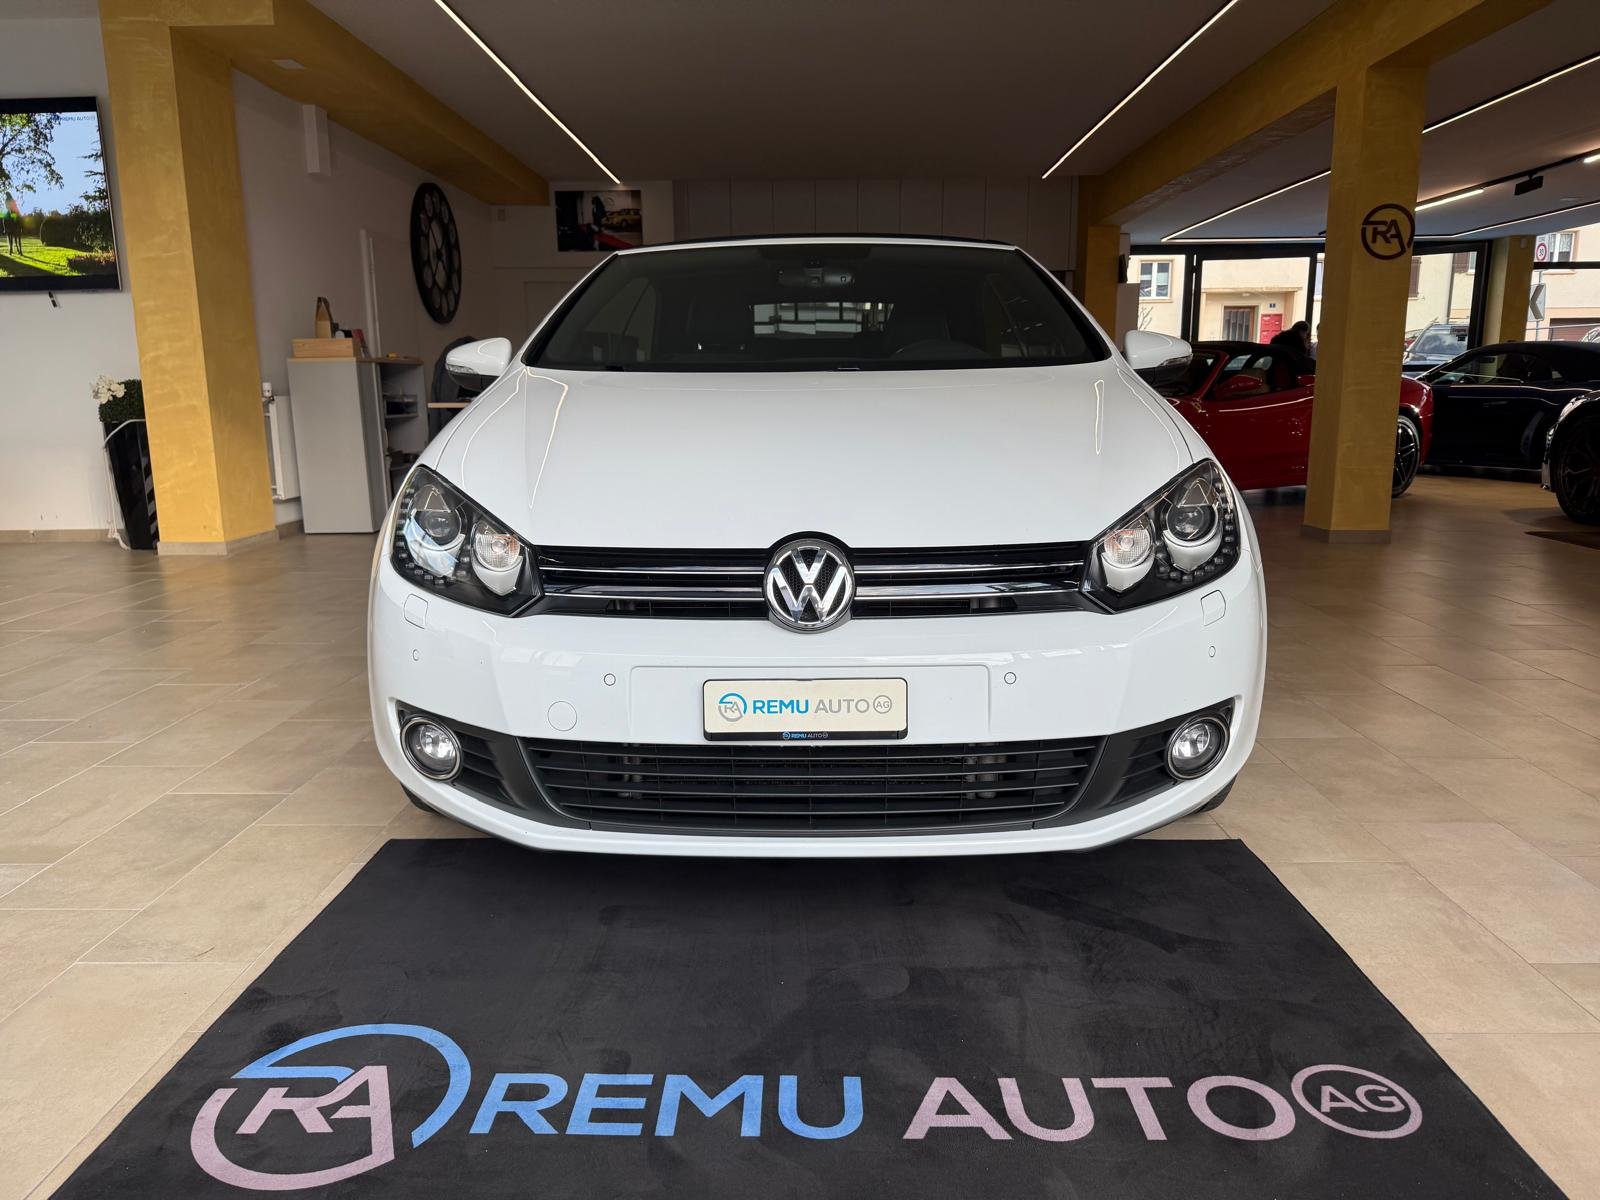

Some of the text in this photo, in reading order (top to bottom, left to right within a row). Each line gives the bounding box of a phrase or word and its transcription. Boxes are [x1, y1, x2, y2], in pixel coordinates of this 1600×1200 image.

[752, 699, 809, 715] REMU
[814, 699, 870, 714] AUTO
[469, 1073, 864, 1140] REMU
[902, 1076, 1297, 1142] AUTO
[1320, 1083, 1406, 1113] AG
